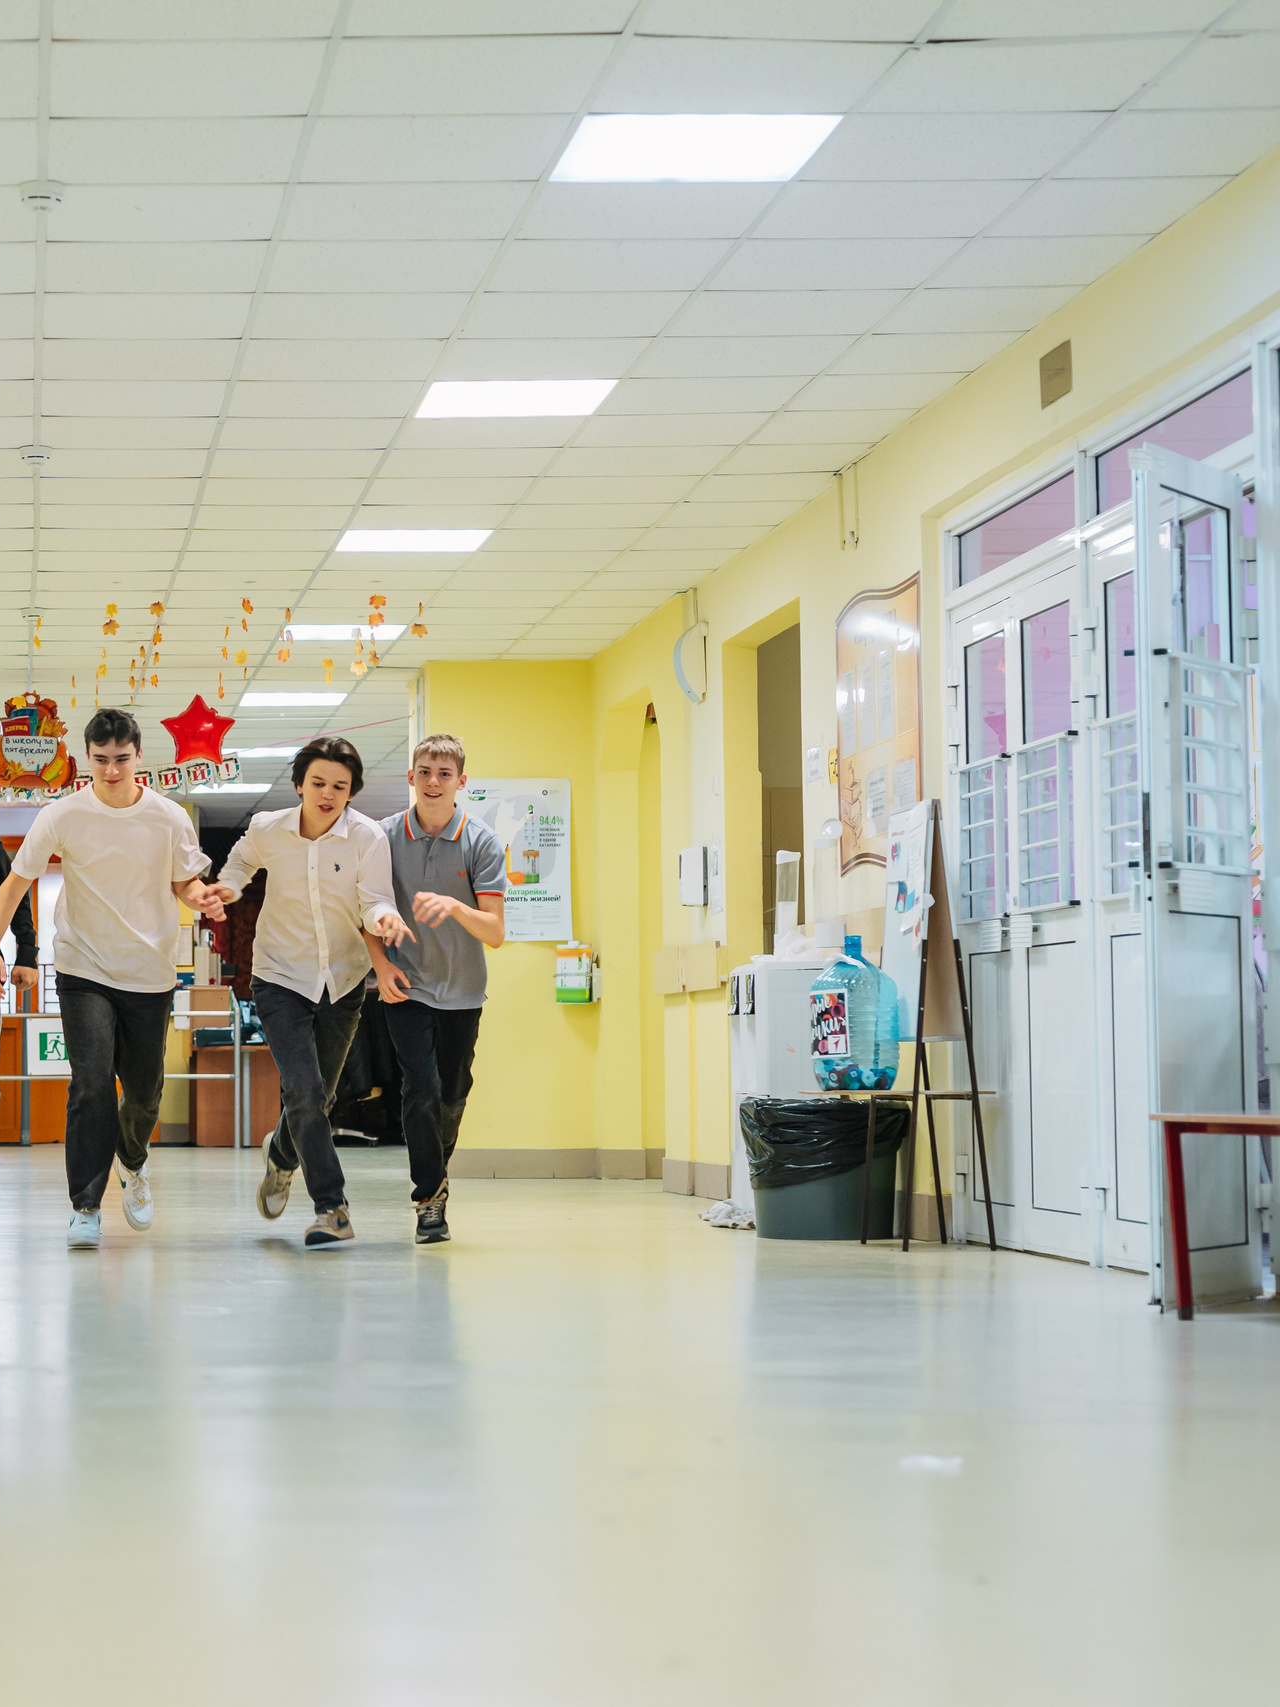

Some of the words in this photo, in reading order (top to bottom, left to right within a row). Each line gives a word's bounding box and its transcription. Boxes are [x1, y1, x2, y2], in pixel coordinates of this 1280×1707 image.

[4, 724, 28, 733] АЗБУКА
[12, 738, 42, 747] школу
[4, 747, 54, 757] пятёрками
[26, 759, 35, 767] 5+
[507, 888, 548, 897] батарейки
[530, 894, 561, 902] жизней!
